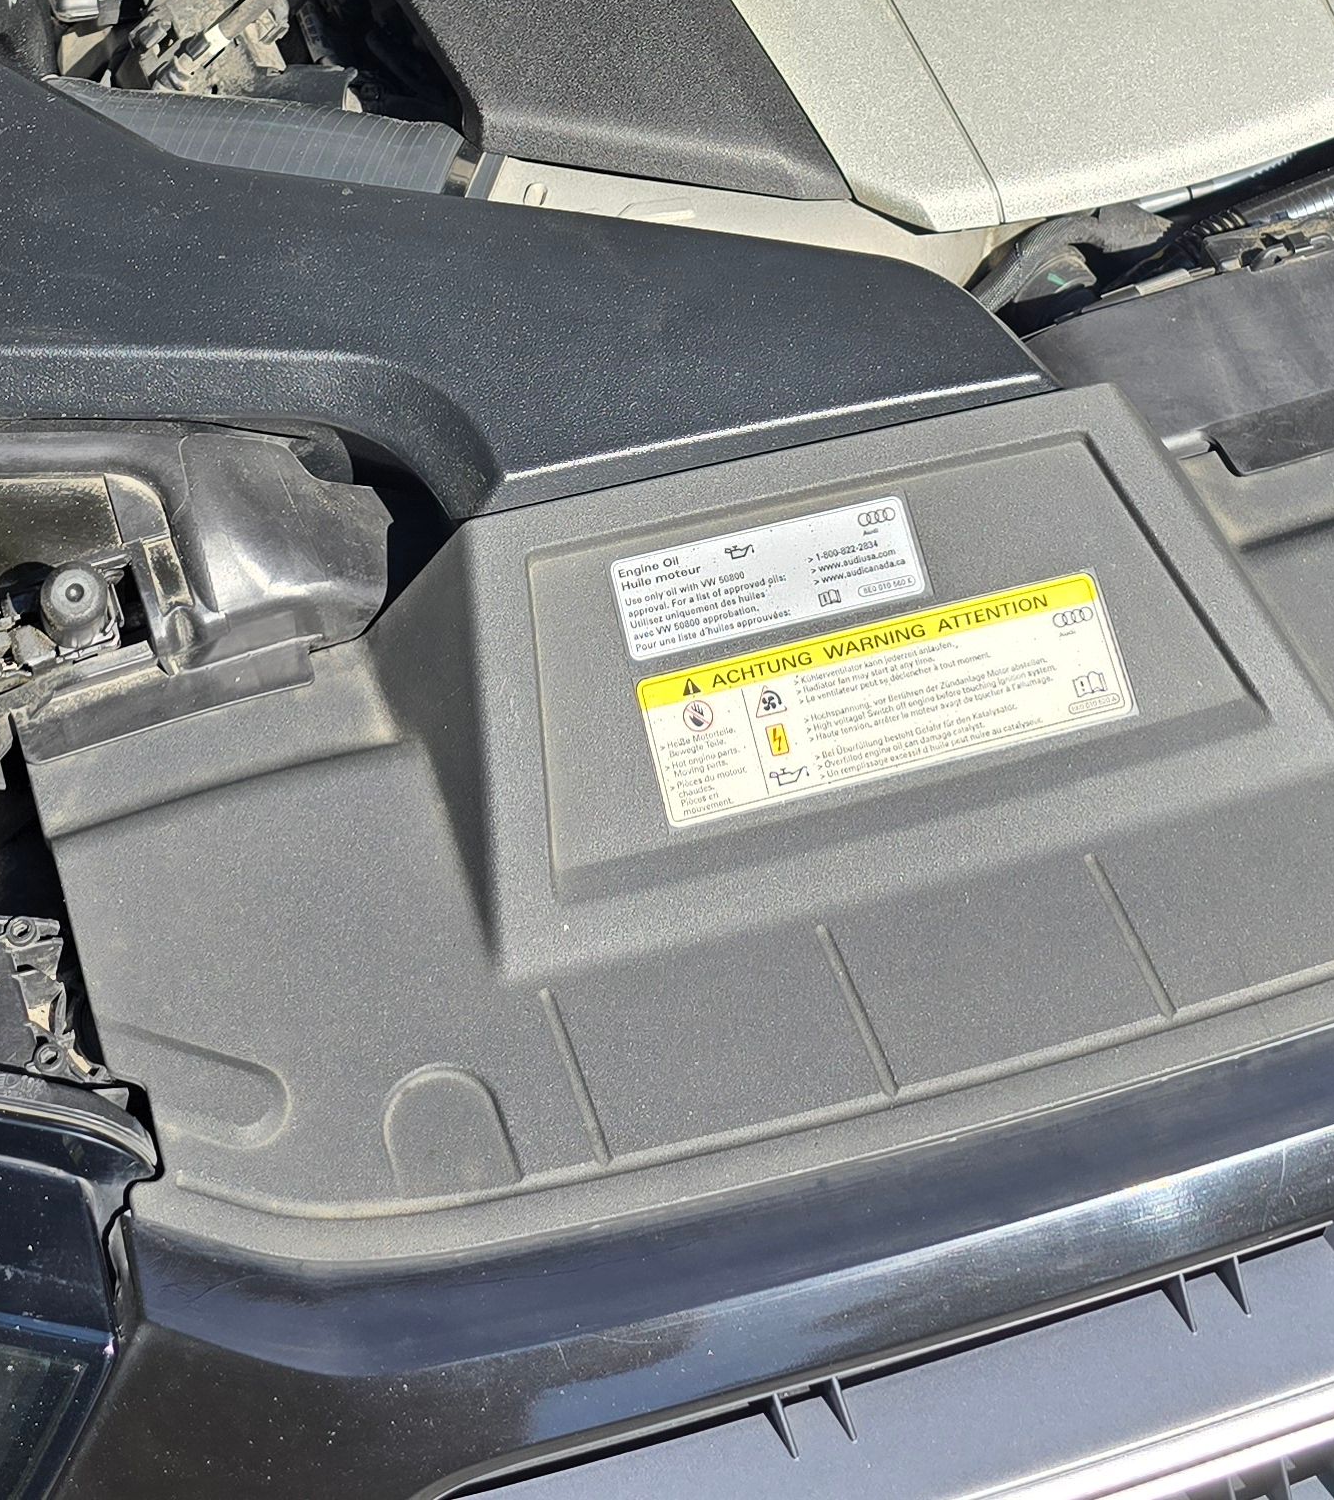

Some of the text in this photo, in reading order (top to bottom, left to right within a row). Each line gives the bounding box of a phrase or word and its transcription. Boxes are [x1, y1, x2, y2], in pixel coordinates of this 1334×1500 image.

[815, 539, 878, 561] 1-800-822-2834
[817, 546, 896, 572] www.audiusa.com
[617, 555, 679, 580] Engine Oil
[620, 564, 701, 591] Huile moteur
[820, 556, 906, 583] www.audicanada.ca
[624, 570, 745, 606] Use only oil with VW 50800
[627, 600, 669, 619] approval.
[671, 596, 687, 607] For
[695, 590, 710, 601] list
[711, 587, 722, 597] of
[722, 577, 766, 596] approved
[766, 572, 786, 584] oils:
[629, 589, 765, 629] Utilisez uniquement des huiles
[632, 602, 759, 640] avec VW 50800 approbation.
[635, 639, 657, 652] Pour
[658, 636, 676, 646] une
[677, 630, 697, 641] liste
[709, 593, 1049, 689] ACHTUNG WARNING ATTENTION
